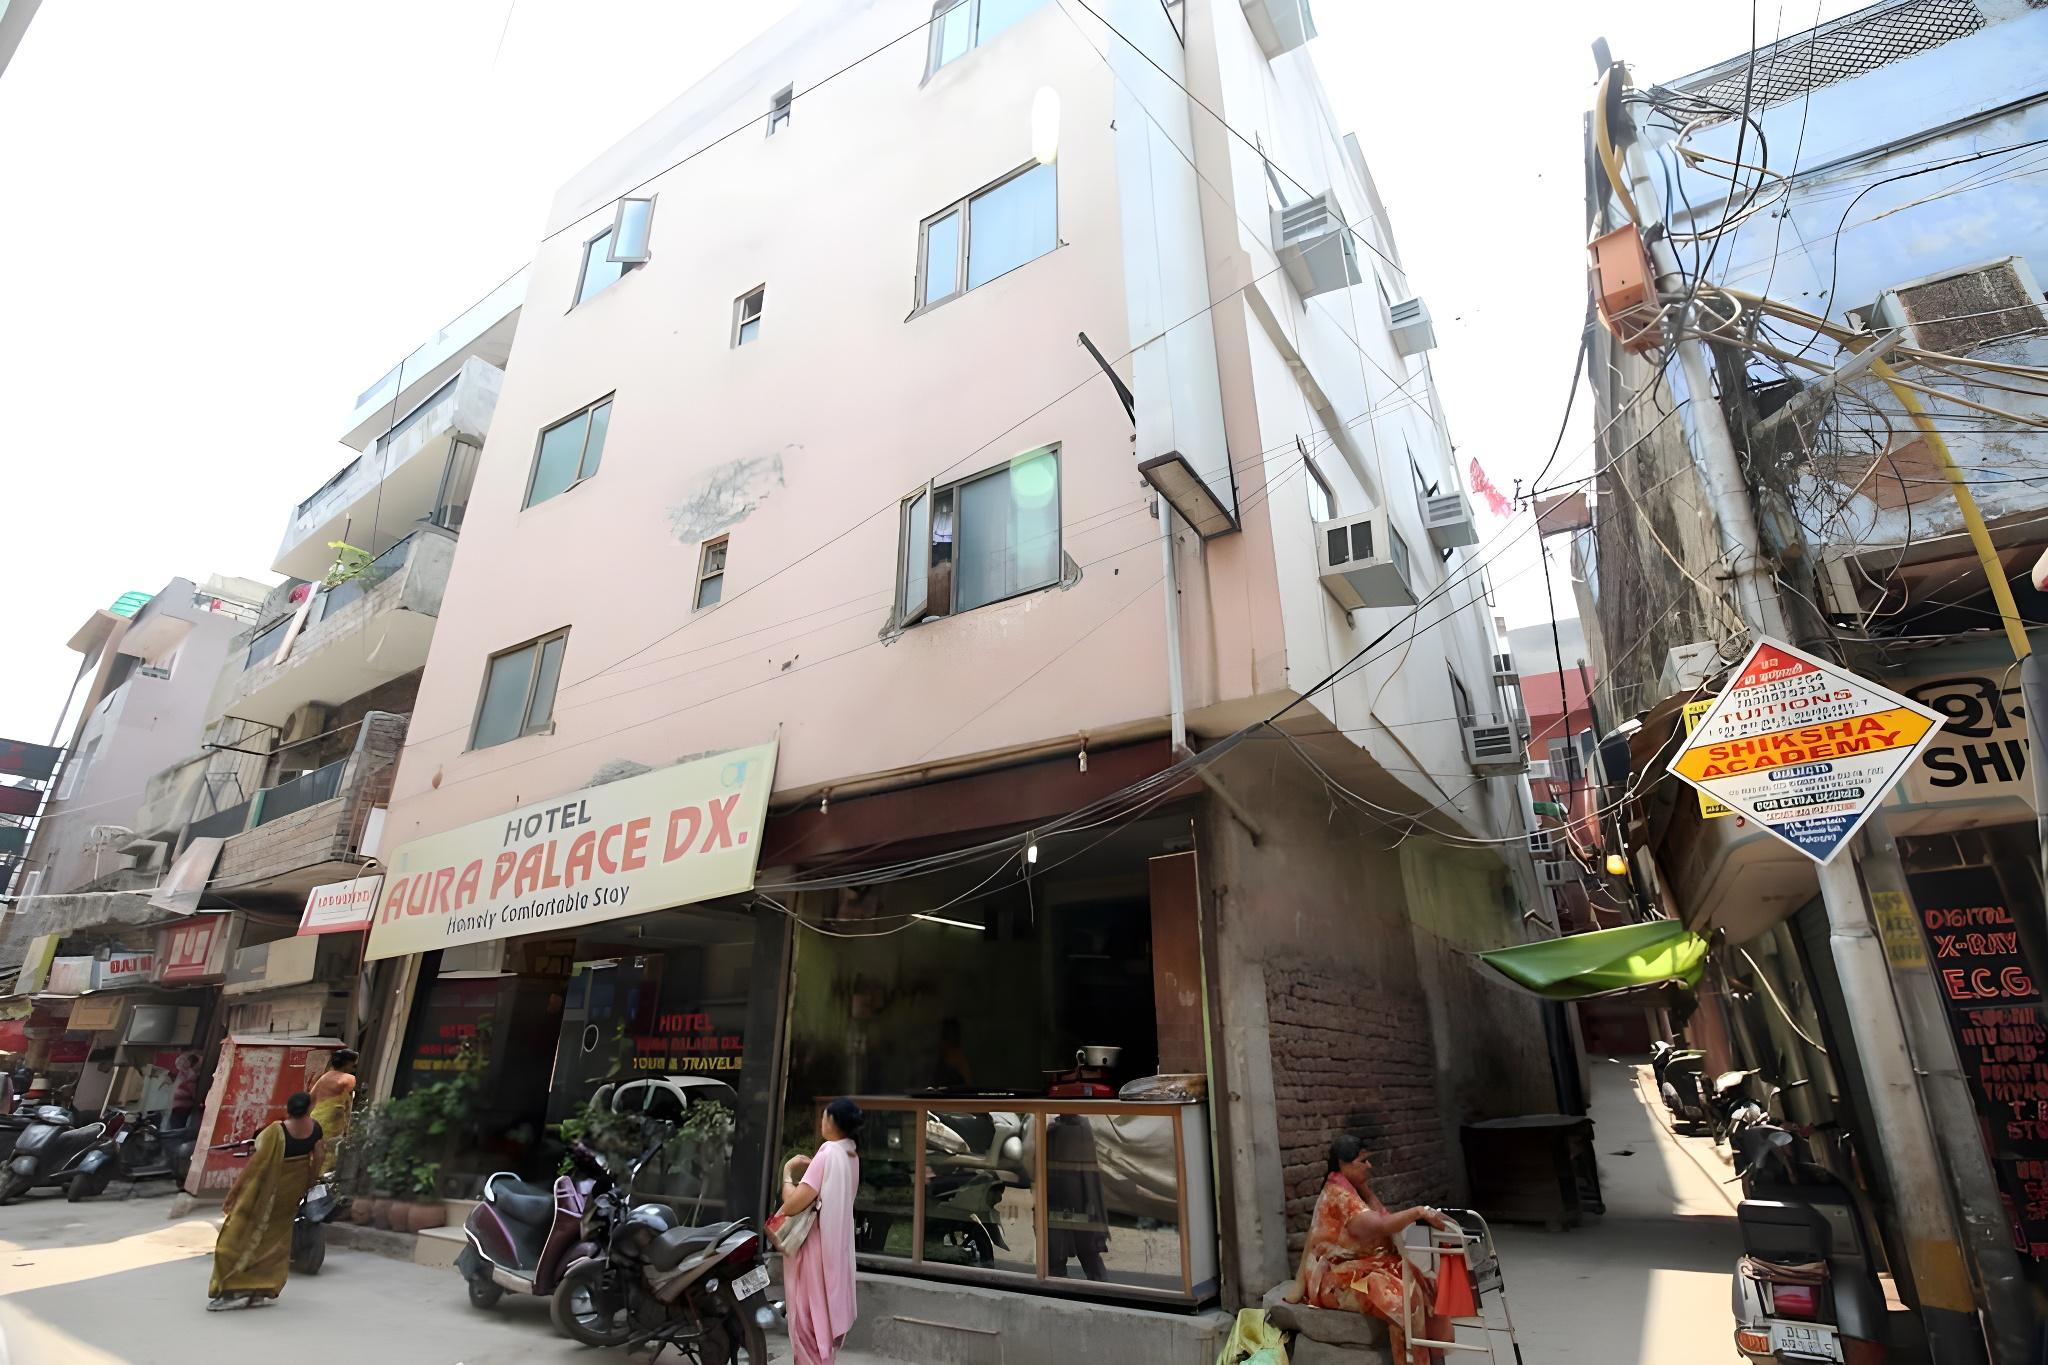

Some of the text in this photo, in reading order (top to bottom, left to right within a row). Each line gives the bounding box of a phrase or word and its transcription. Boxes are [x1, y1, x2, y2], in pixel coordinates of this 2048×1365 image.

[1719, 689, 1852, 724] TUITIONS
[1703, 731, 1901, 777] ACADEMY
[1709, 717, 1886, 761] SHIKSHA
[504, 800, 591, 847] HOTEL
[382, 793, 748, 924] AURA PALACE DX.
[502, 890, 589, 924] Comfortable
[593, 886, 630, 906] Stay
[1934, 932, 2017, 958] X-RAY
[659, 1013, 714, 1032] HOTEL
